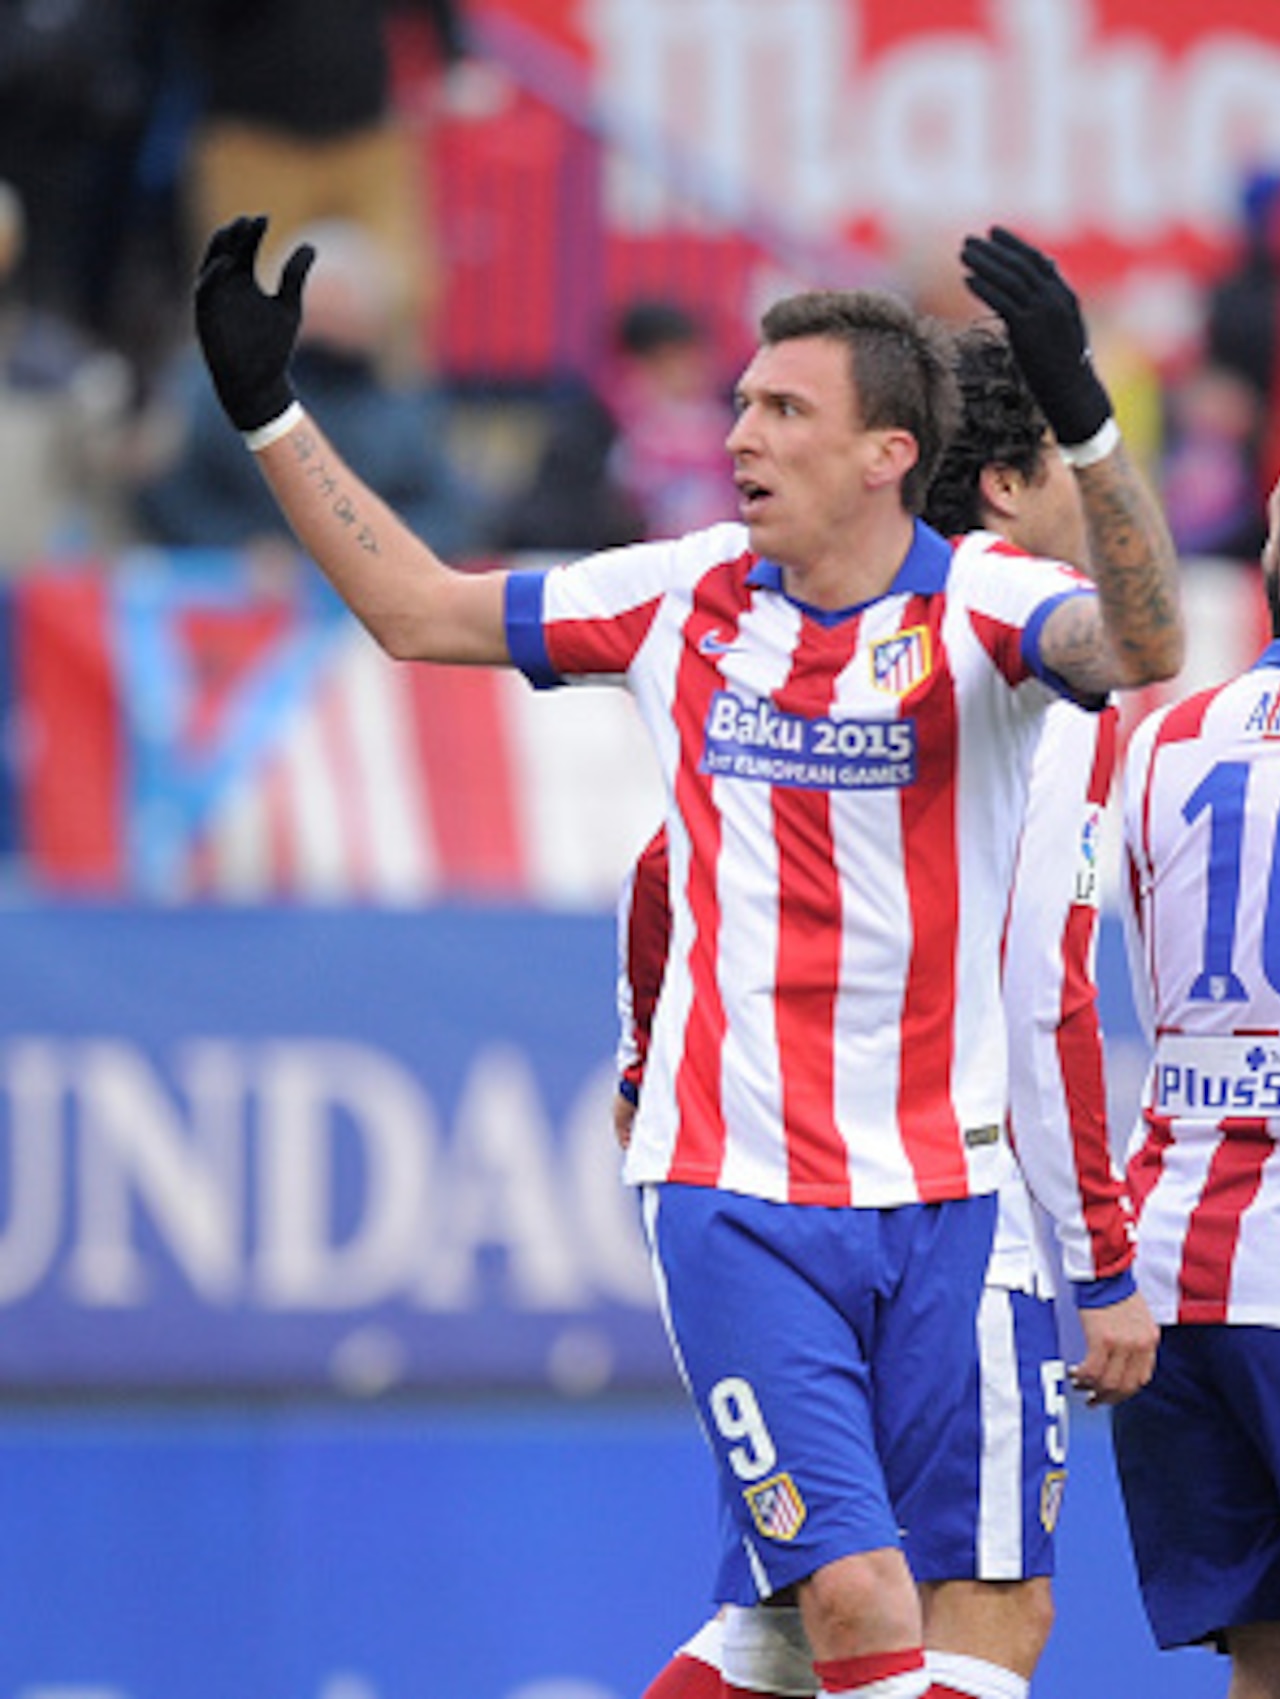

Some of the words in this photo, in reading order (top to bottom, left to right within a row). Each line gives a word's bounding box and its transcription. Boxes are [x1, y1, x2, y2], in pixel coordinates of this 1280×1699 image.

[708, 697, 802, 751] Baku
[812, 723, 911, 761] 2015
[734, 754, 836, 784] EUROPEAN
[839, 765, 911, 785] GAMES
[709, 1376, 778, 1482] 9
[1040, 1360, 1069, 1464] 5
